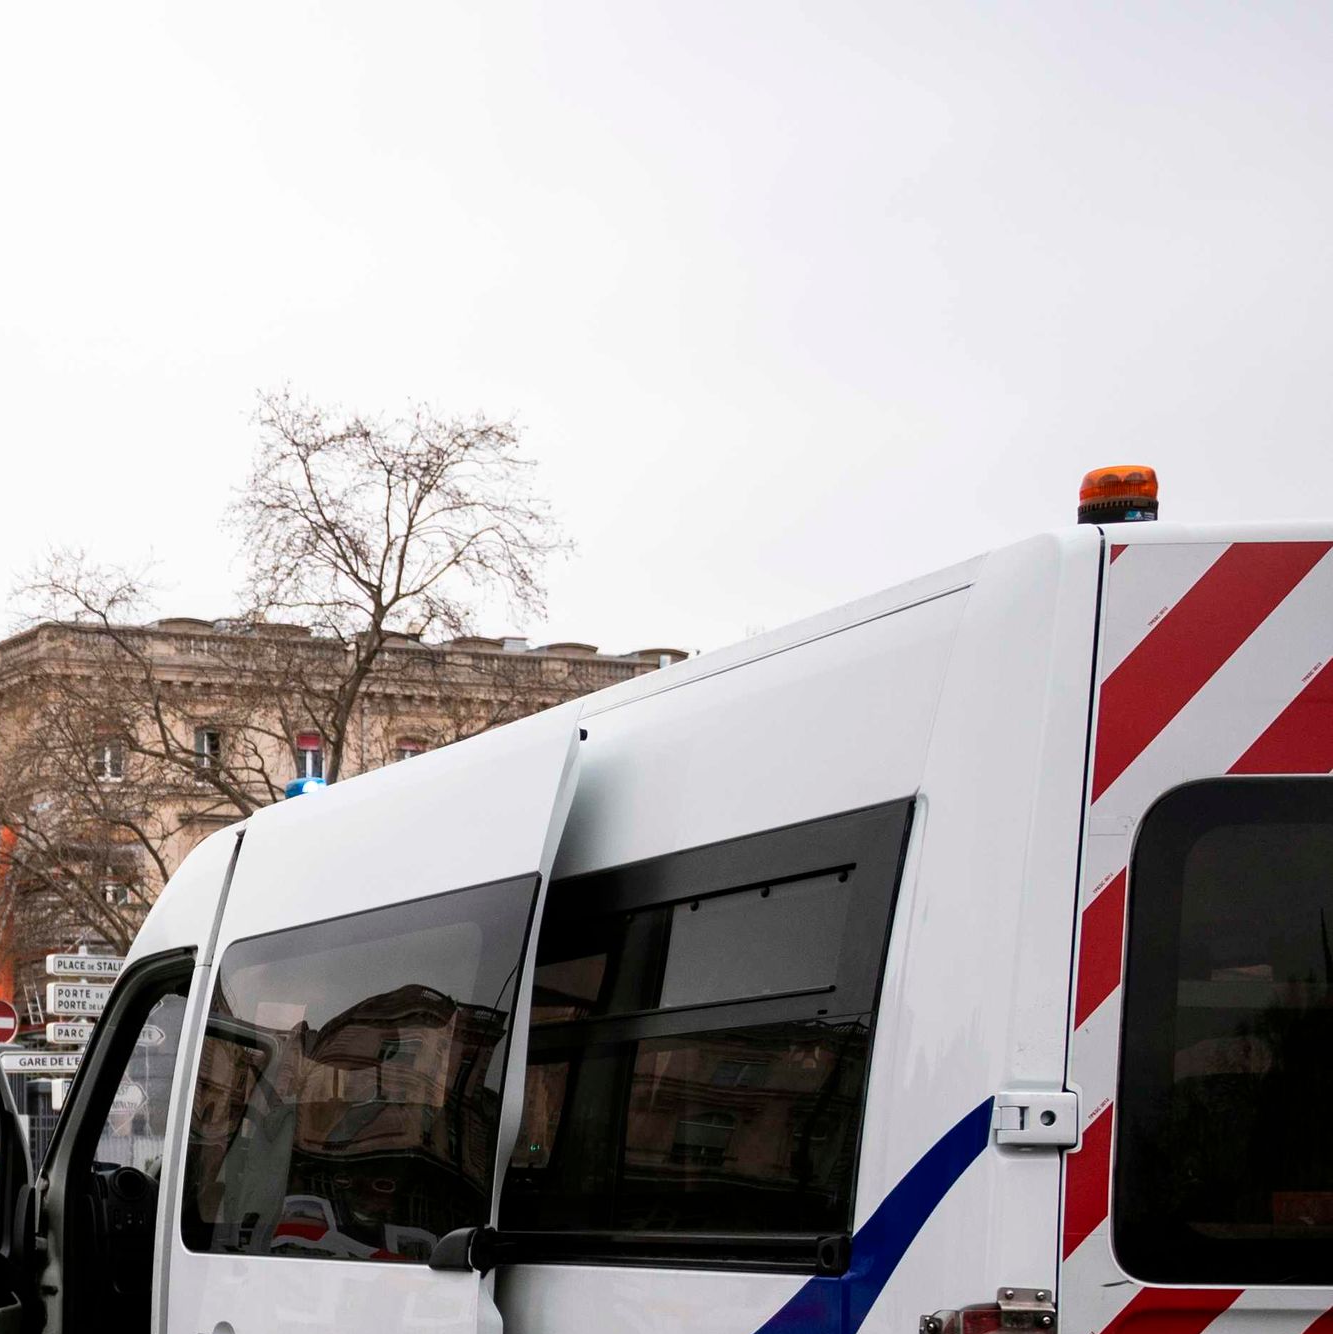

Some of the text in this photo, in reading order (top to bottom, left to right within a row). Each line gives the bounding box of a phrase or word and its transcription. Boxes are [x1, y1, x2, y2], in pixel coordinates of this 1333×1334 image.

[57, 960, 85, 970] PLACE
[97, 962, 123, 972] STALI
[58, 989, 90, 998] PORTE
[58, 1000, 87, 1010] PORTE
[58, 1028, 84, 1038] PARC
[19, 1057, 47, 1066] GARE
[50, 1057, 64, 1066] DE
